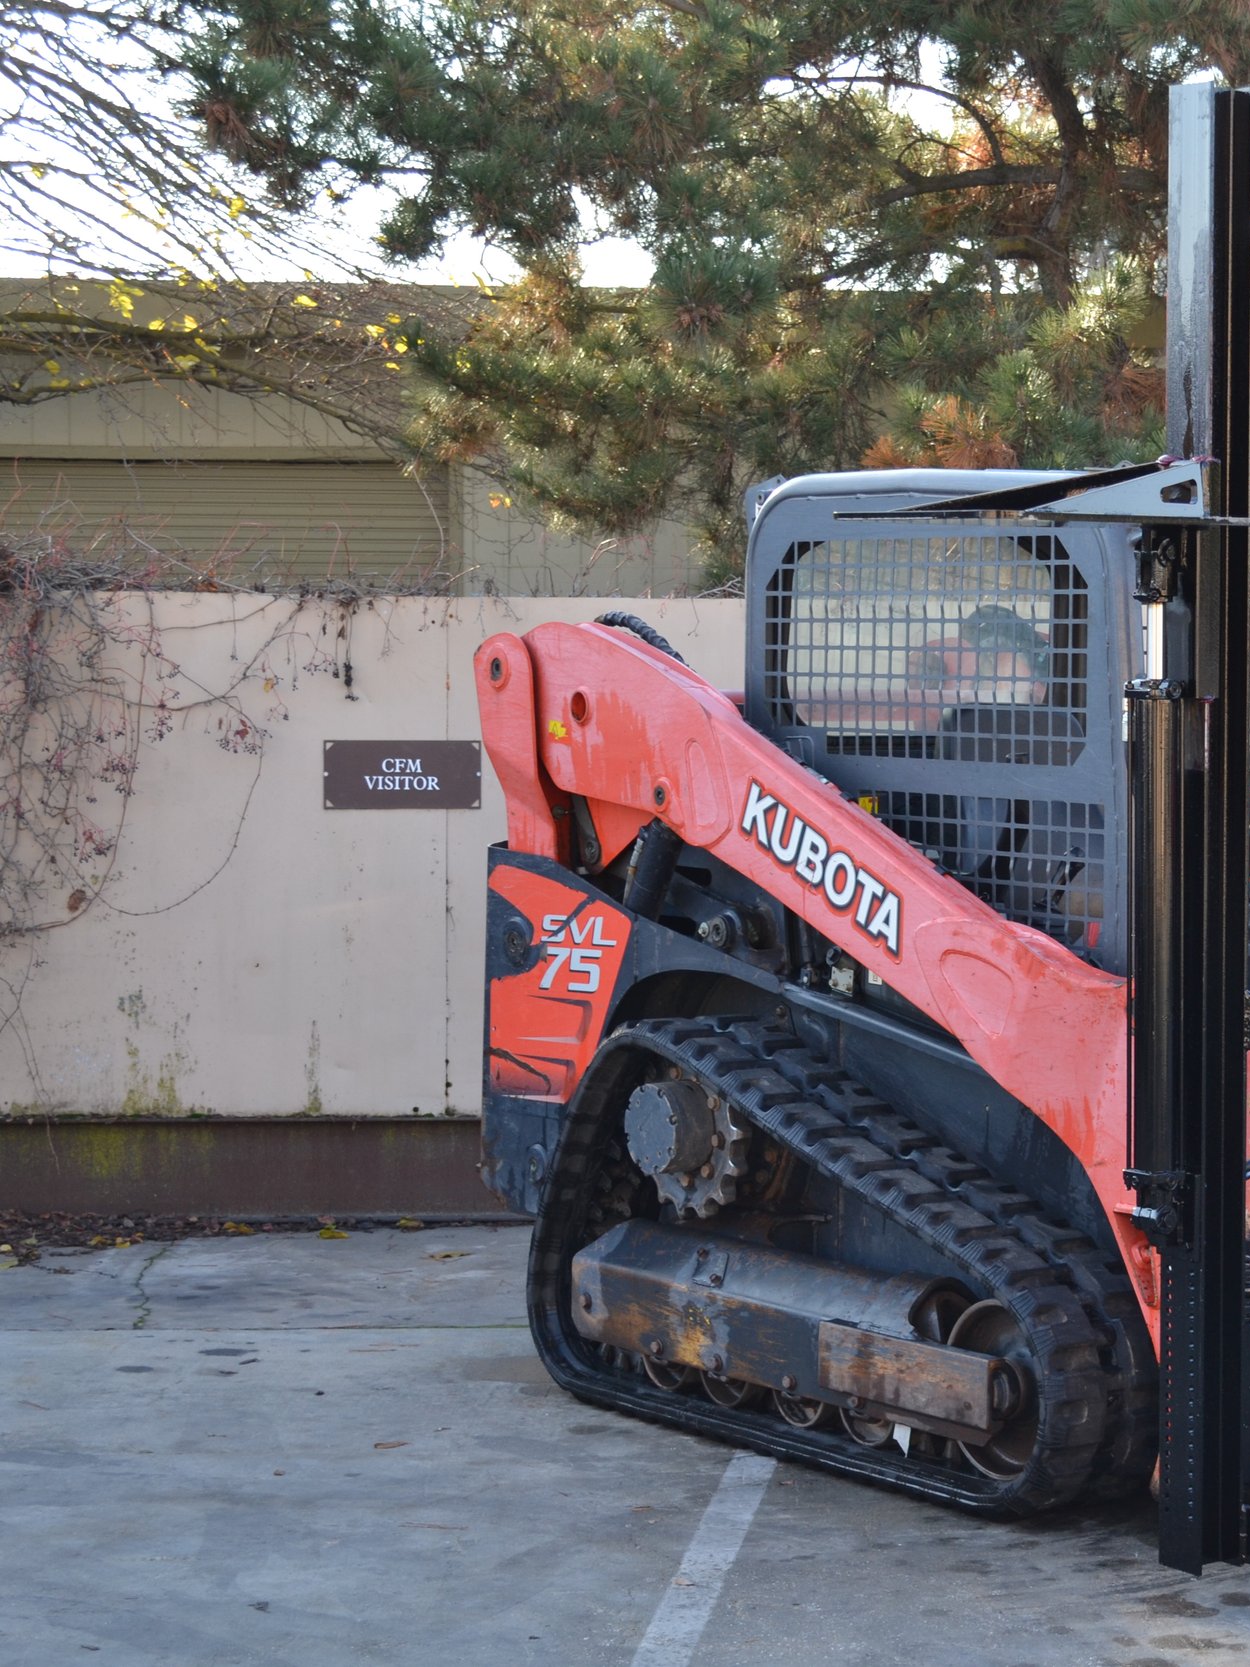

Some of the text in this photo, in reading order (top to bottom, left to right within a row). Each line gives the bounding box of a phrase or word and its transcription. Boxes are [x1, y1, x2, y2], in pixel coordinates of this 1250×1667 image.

[381, 758, 423, 773] CFM
[364, 775, 441, 791] VISITOR
[741, 781, 900, 953] KUBOTA
[540, 914, 617, 946] SVL
[538, 946, 603, 993] 75
